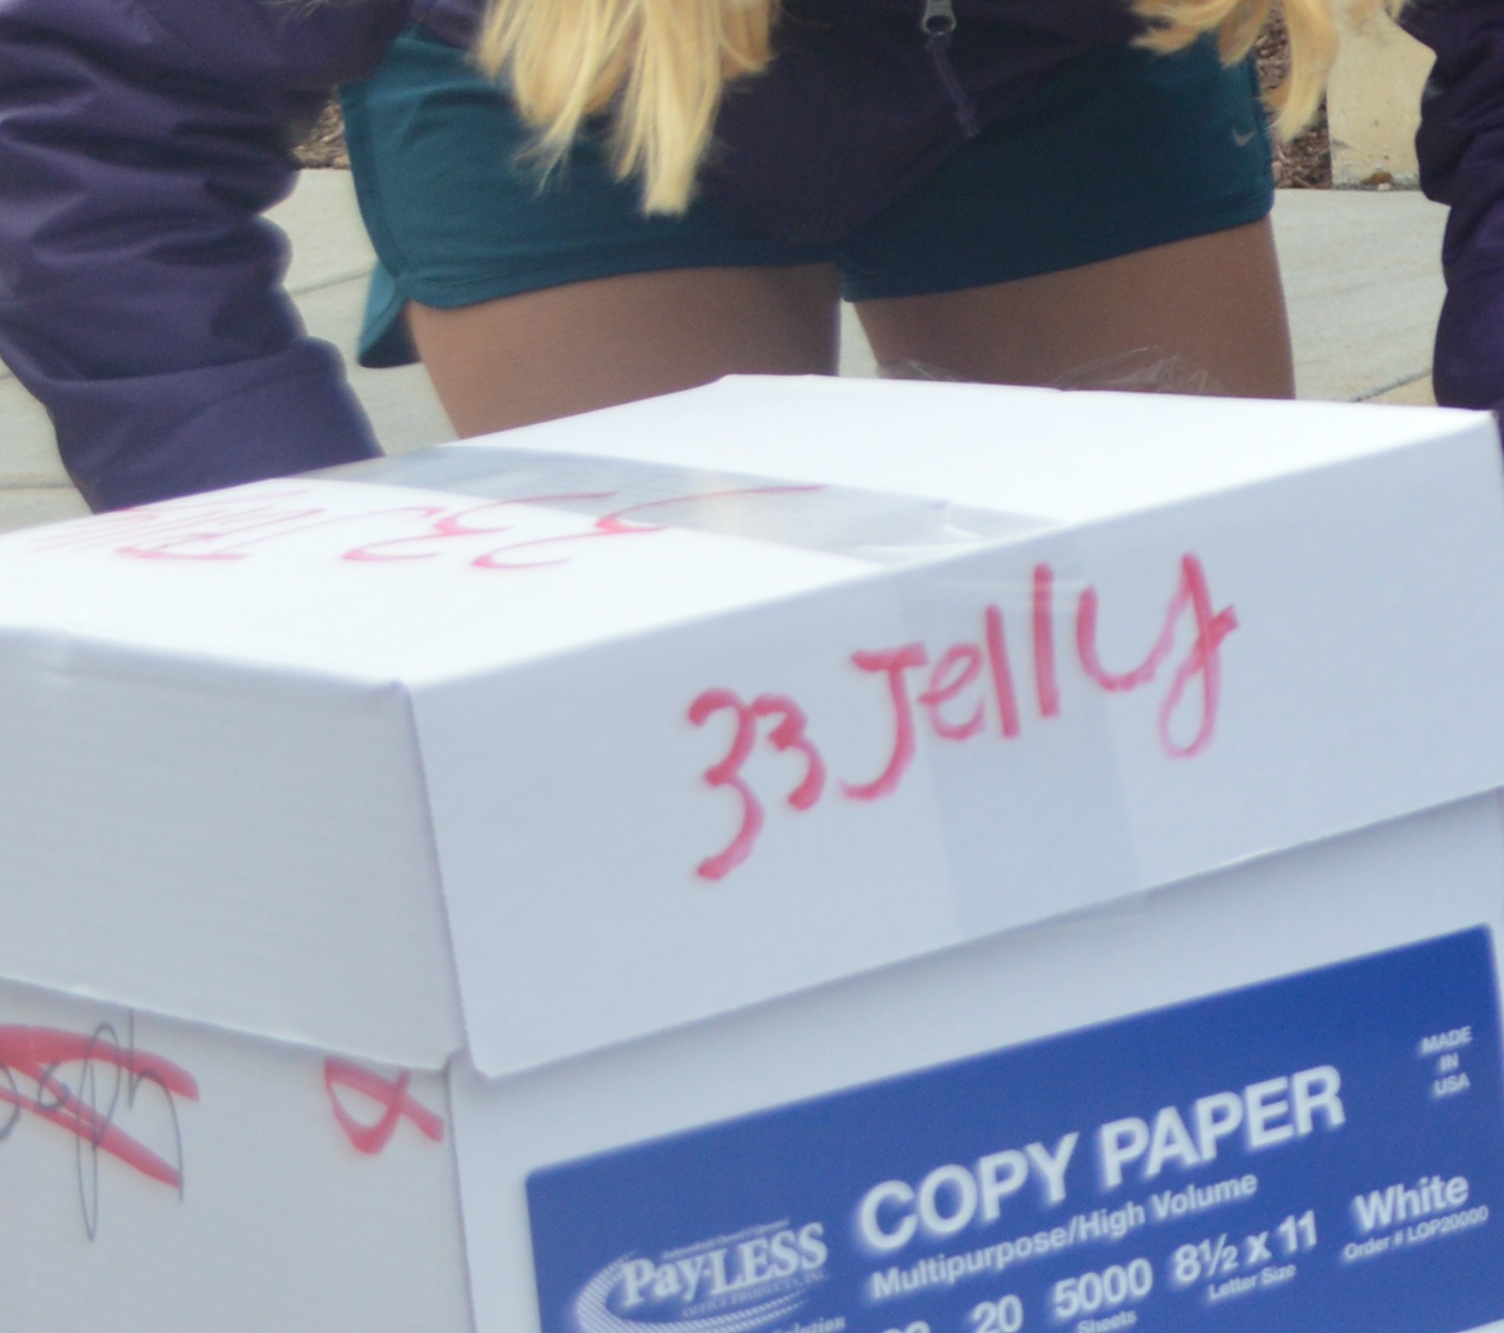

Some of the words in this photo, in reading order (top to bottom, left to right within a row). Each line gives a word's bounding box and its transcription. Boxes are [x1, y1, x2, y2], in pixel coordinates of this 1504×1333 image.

[1420, 1025, 1472, 1056] MADE
[1438, 1052, 1459, 1073] IN
[1433, 1073, 1470, 1099] USA
[859, 1131, 1078, 1253] COPY
[1102, 1063, 1346, 1189] PAPER
[1352, 1175, 1470, 1234] White
[869, 1199, 1146, 1301] Multipurpose/High
[1151, 1173, 1258, 1221] Volume
[1279, 1209, 1319, 1254] 11
[972, 1294, 1024, 1333] 20
[1052, 1258, 1154, 1320] 5000
[1206, 1269, 1258, 1303] Letter
[1260, 1262, 1297, 1290] Size
